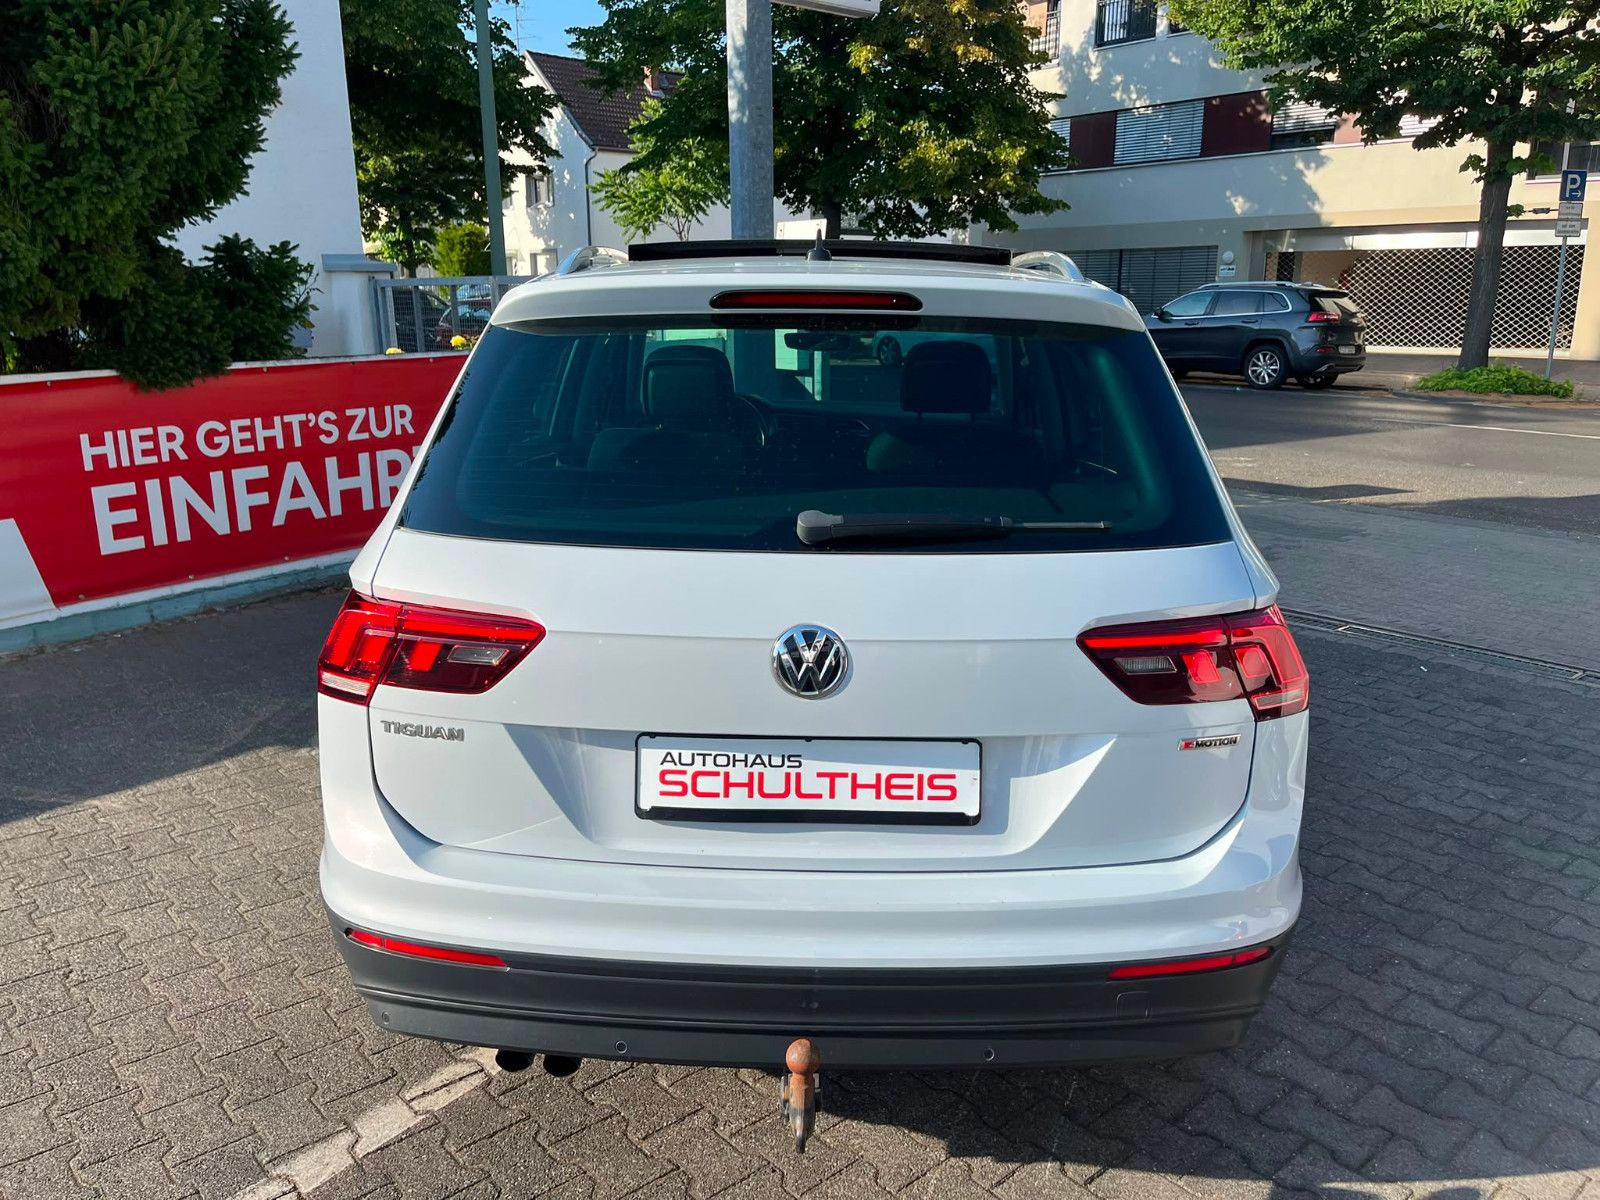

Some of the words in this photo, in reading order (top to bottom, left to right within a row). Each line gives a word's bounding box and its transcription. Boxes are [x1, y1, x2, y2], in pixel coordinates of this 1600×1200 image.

[1565, 173, 1581, 198] P
[80, 424, 189, 472] HIER
[196, 409, 340, 458] GEHT'S
[346, 403, 415, 441] ZUR
[90, 446, 423, 556] EINFAHR
[380, 720, 465, 742] TIGUAN
[659, 751, 803, 769] AUTOHAUS
[658, 768, 958, 802] SCHULTHEIS
